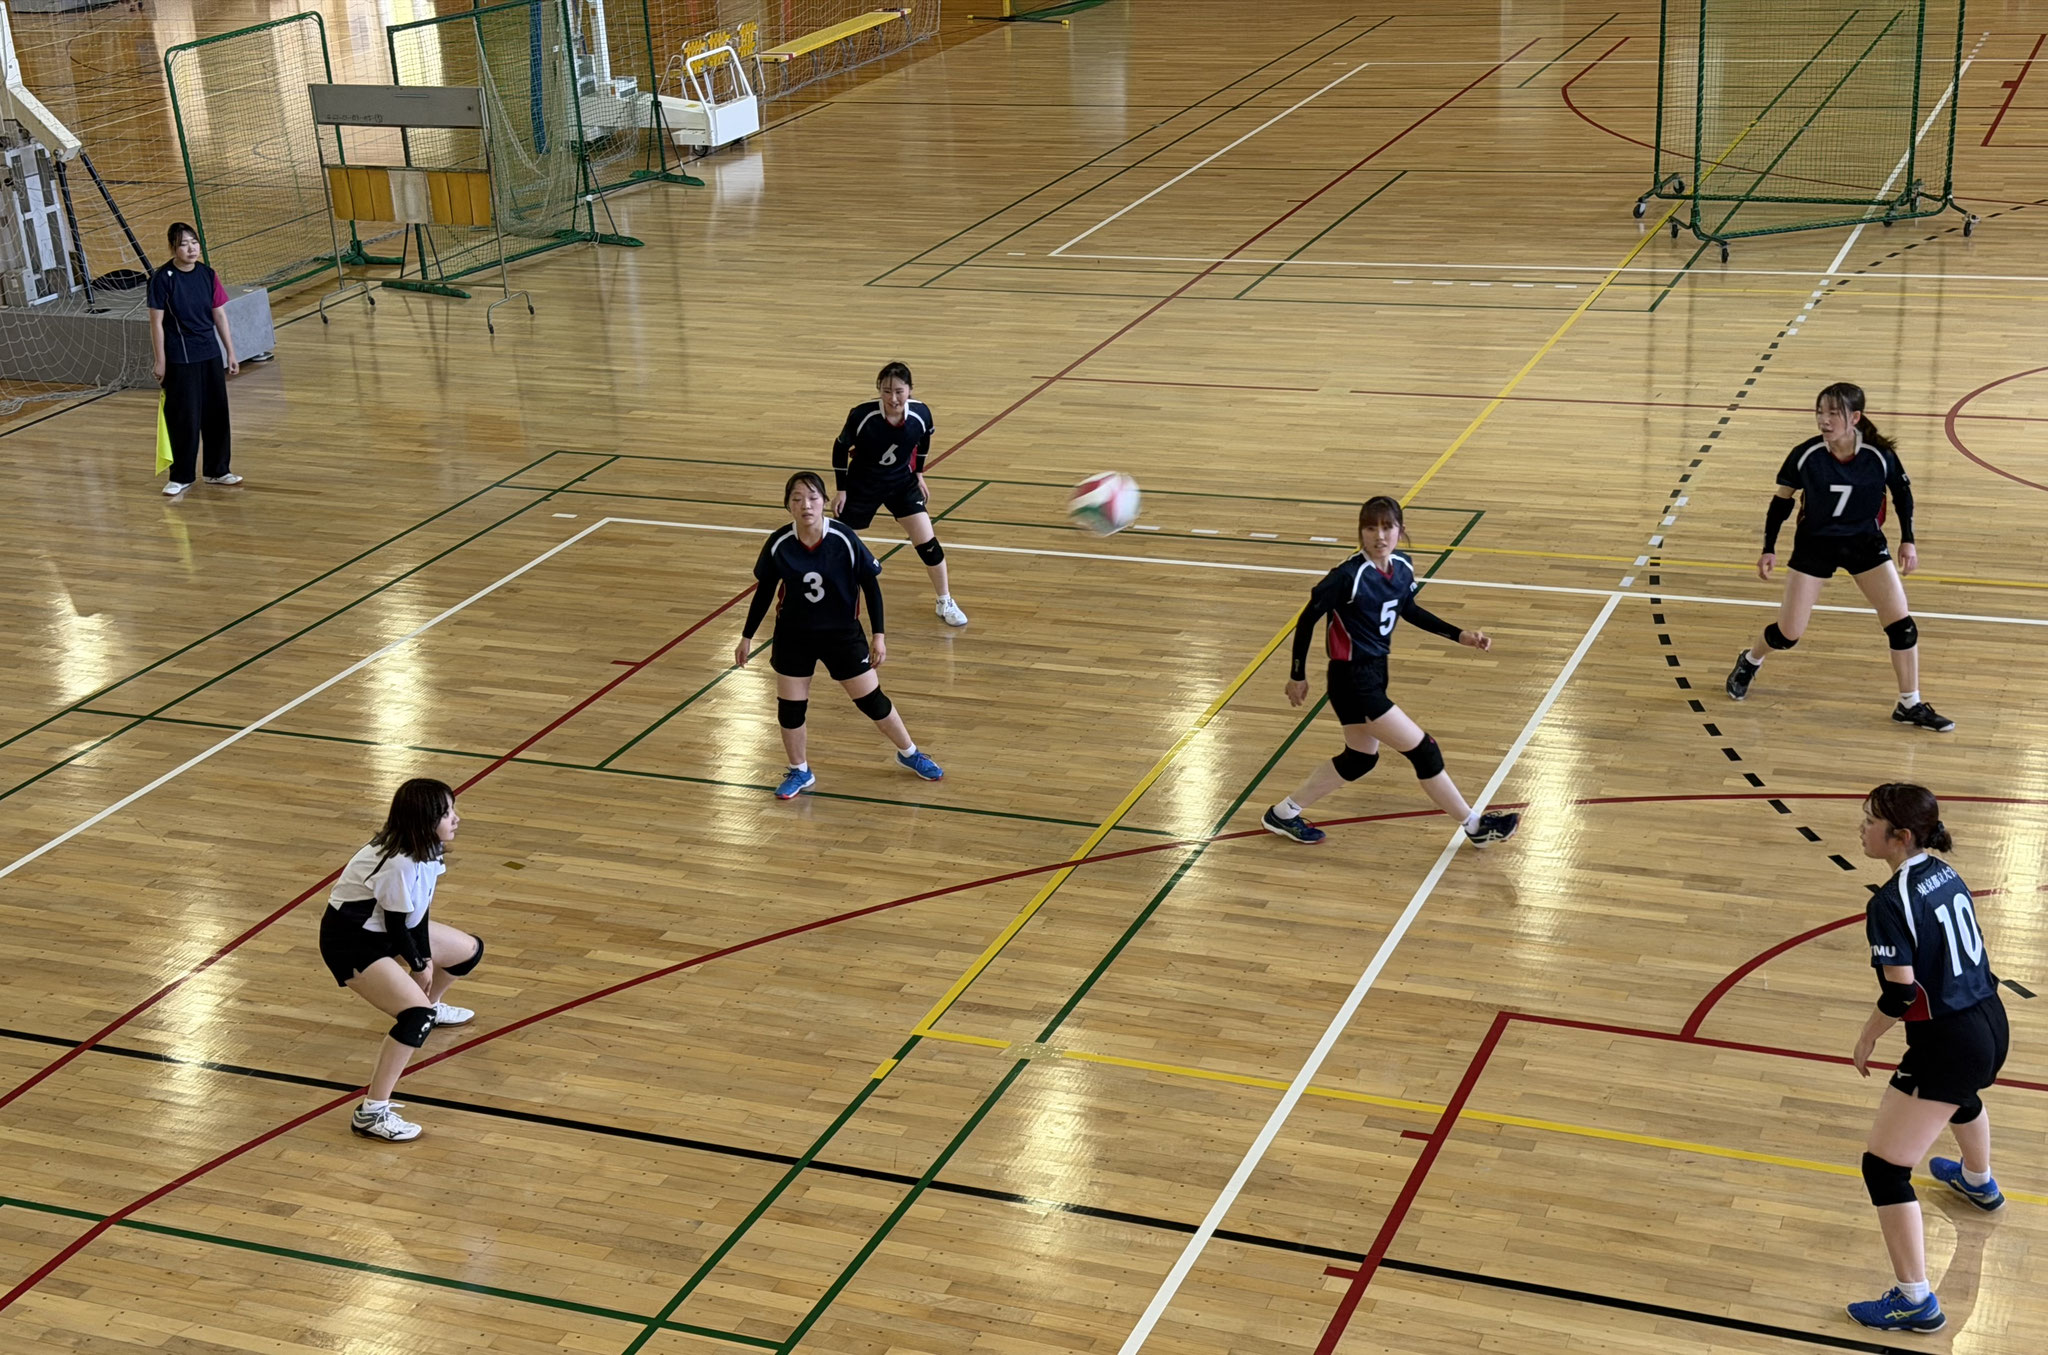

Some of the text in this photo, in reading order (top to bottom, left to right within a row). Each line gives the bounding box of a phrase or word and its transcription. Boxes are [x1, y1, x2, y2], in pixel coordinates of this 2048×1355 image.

[879, 443, 898, 466] 6
[1829, 484, 1853, 517] 7
[802, 571, 826, 604] 3
[1379, 599, 1399, 636] 5
[1934, 892, 1983, 977] 10
